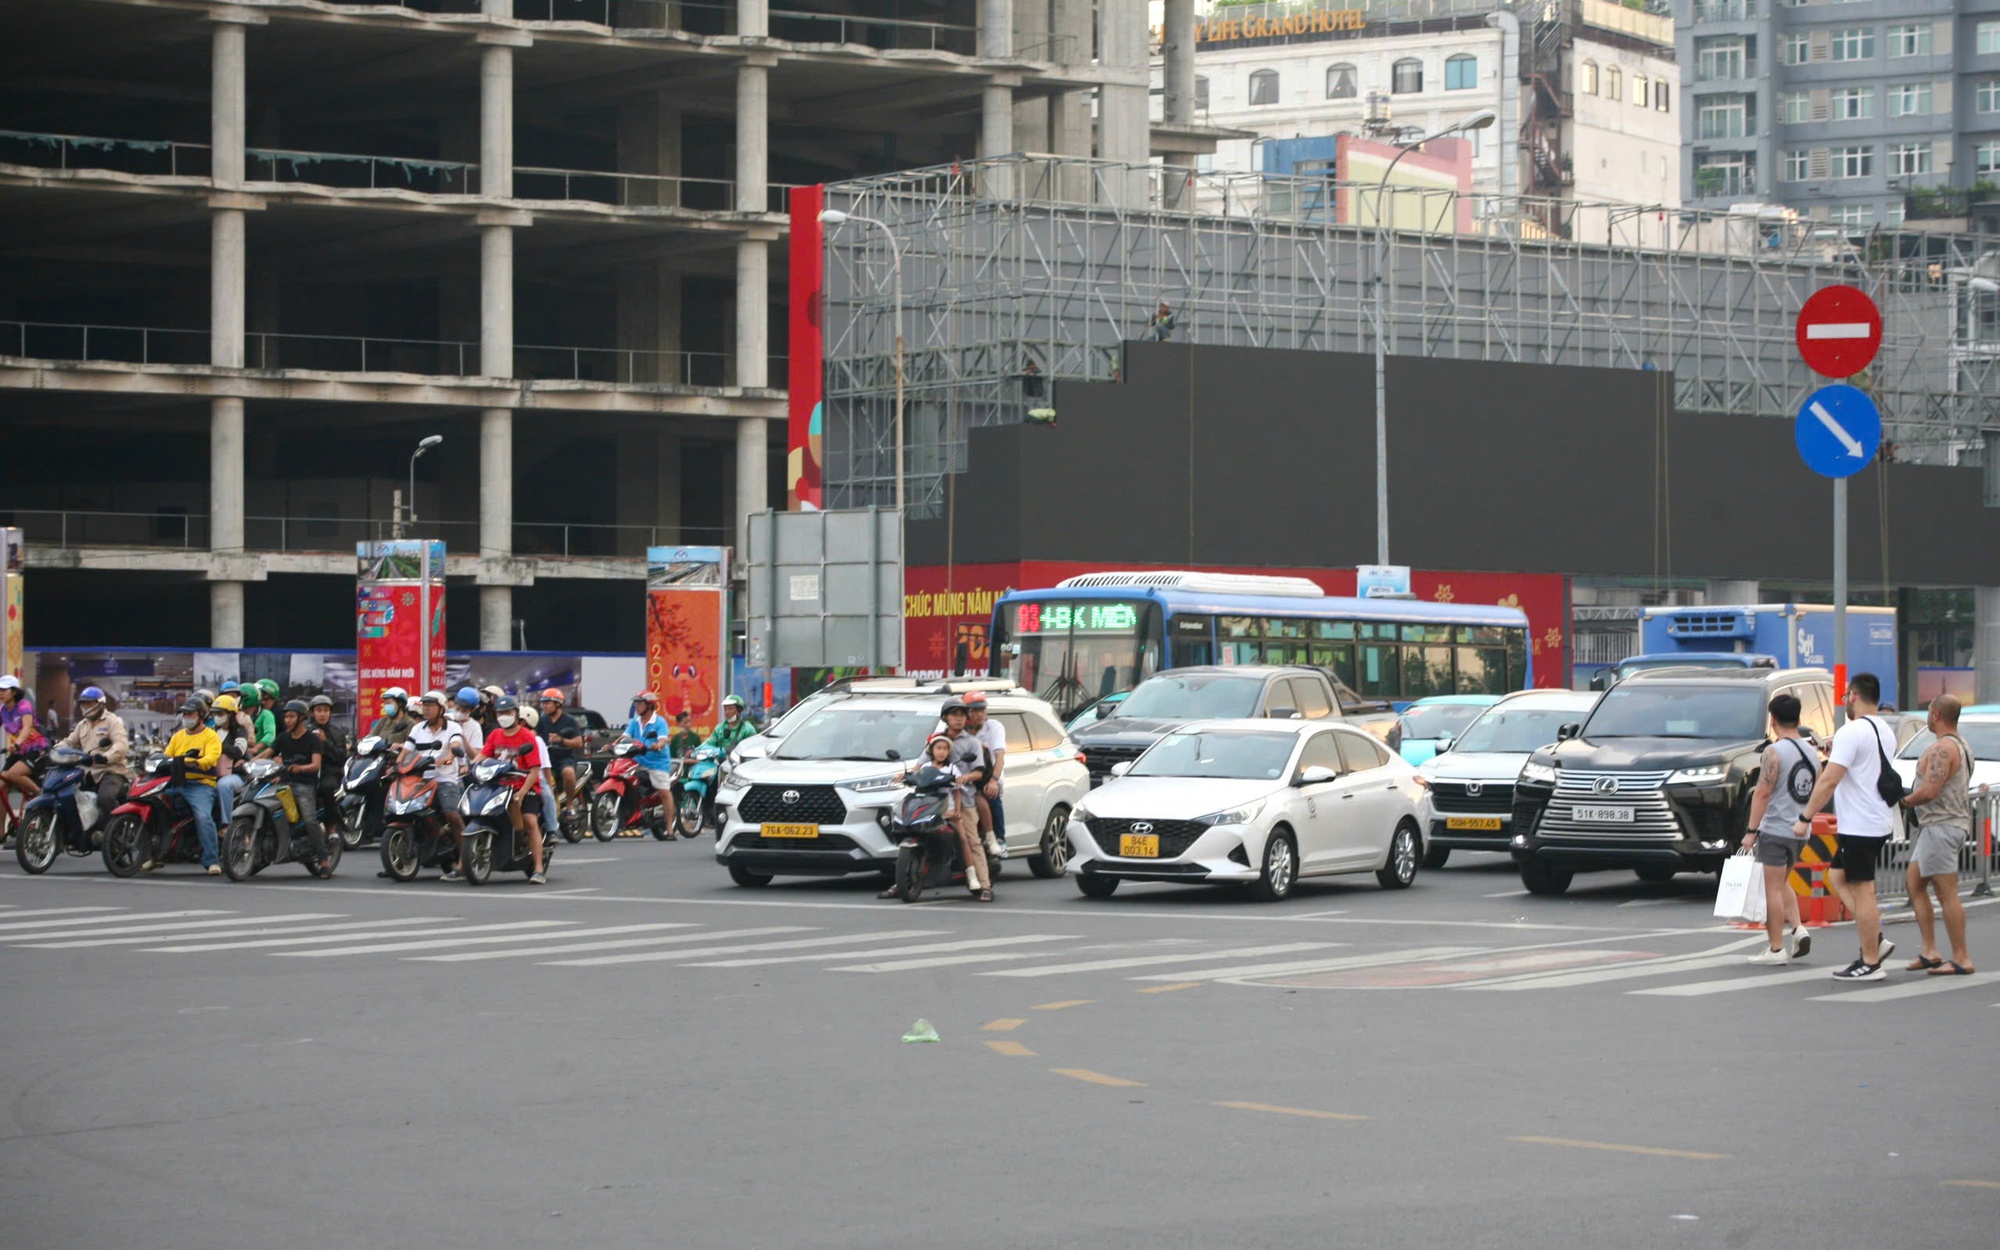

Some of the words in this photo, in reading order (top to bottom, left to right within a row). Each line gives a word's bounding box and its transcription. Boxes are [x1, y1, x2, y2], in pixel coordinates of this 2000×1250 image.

[1207, 19, 1239, 42] LIFE
[1242, 14, 1308, 38] GRAND
[1310, 9, 1365, 33] HOTEL
[904, 590, 932, 618] CHÚC
